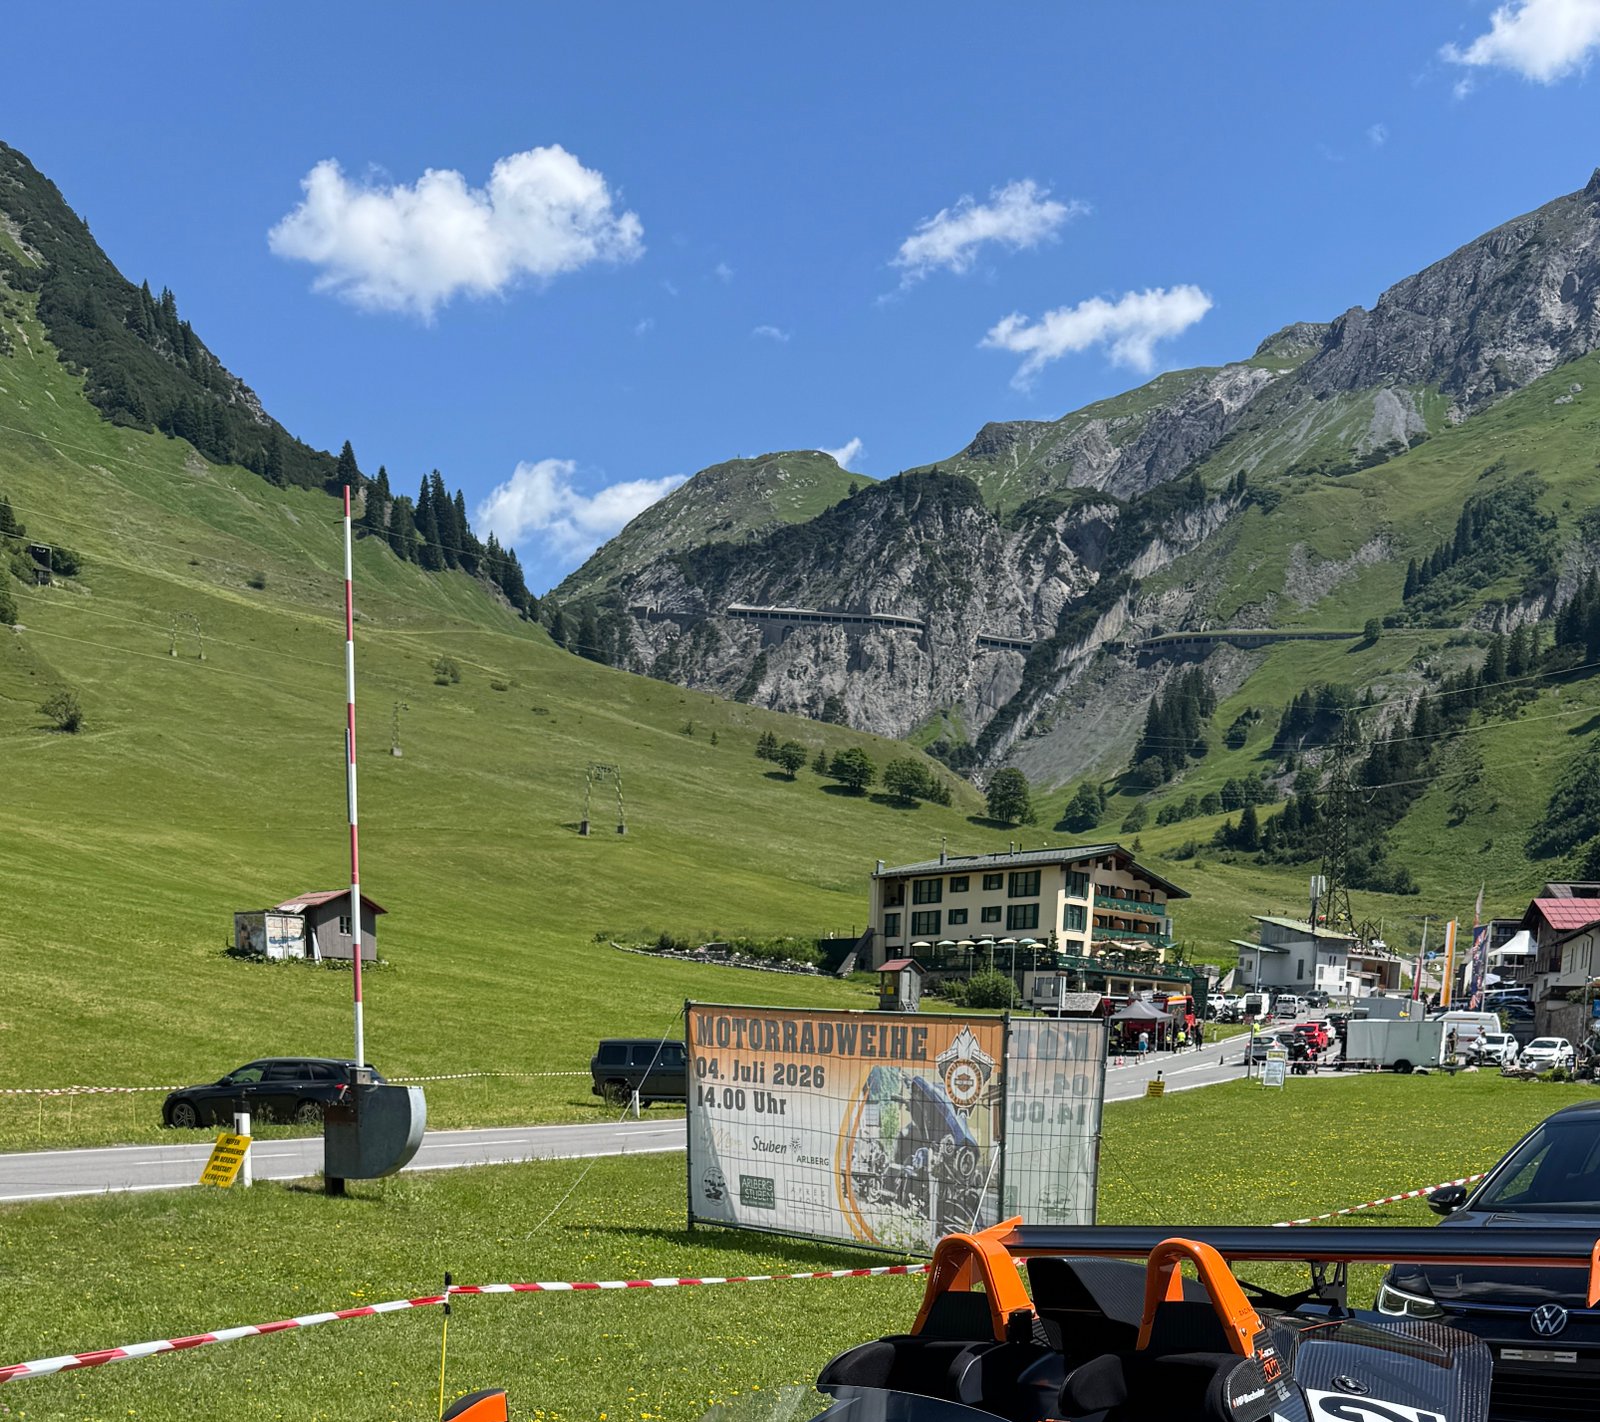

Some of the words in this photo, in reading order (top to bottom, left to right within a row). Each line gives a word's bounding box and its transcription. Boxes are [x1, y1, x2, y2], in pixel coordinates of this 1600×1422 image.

[697, 1015, 928, 1060] MOTORRADWEIHE
[696, 1056, 725, 1080] 04.
[732, 1059, 765, 1083] Juli
[773, 1062, 825, 1088] 2026
[697, 1085, 745, 1111] 14.00
[753, 1090, 787, 1115] Uhr
[751, 1135, 787, 1154] Stuben
[796, 1155, 829, 1166] ARLBERG
[741, 1178, 773, 1191] ARLBERG
[744, 1188, 774, 1202] STUBEN
